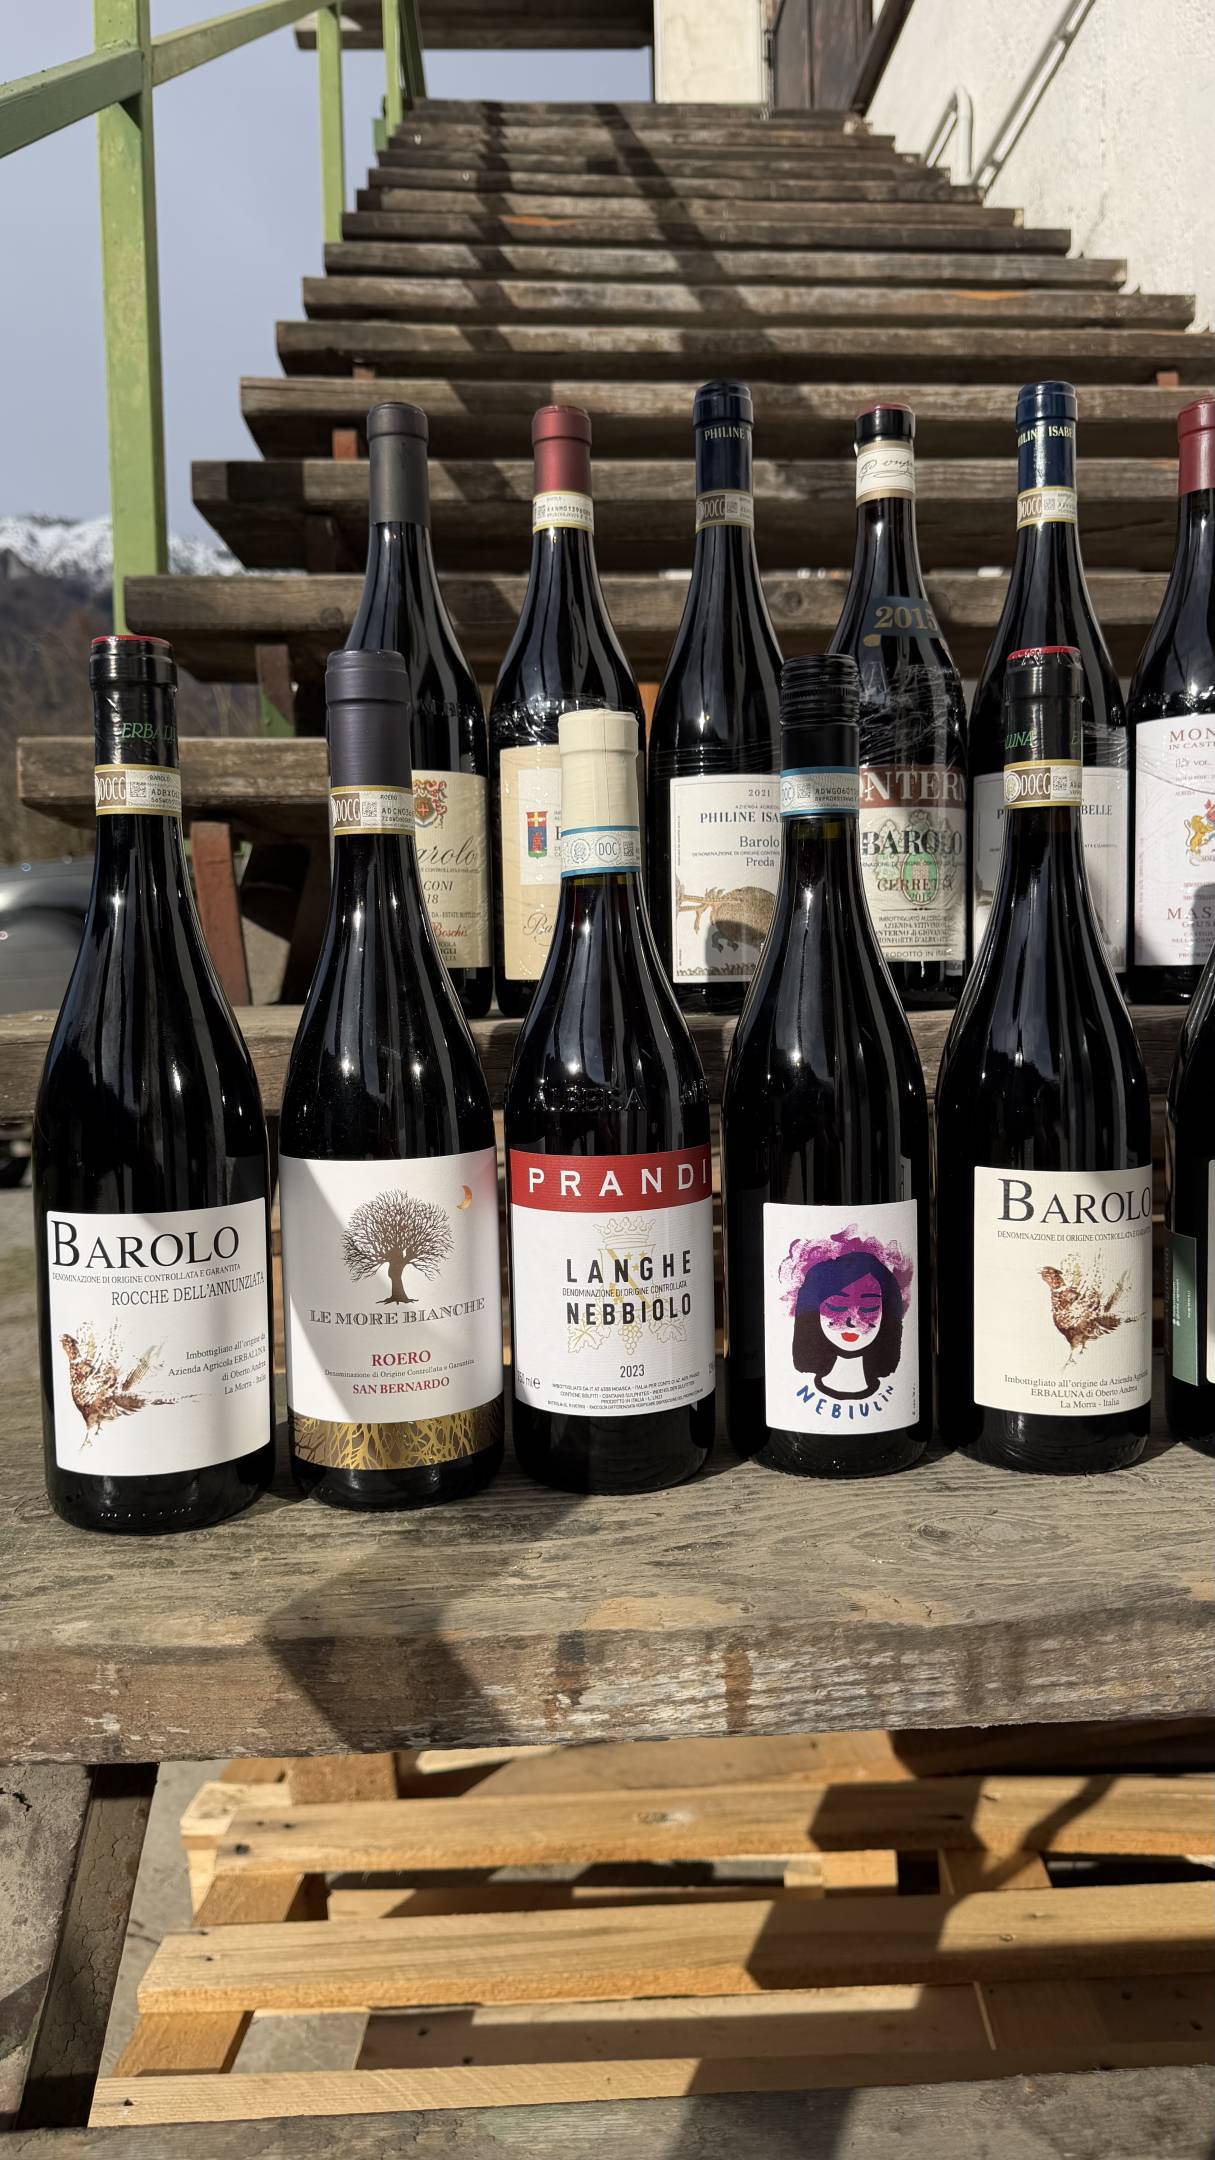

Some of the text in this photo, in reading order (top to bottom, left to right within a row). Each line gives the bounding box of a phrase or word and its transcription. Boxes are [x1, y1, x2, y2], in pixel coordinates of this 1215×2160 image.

[704, 426, 745, 440] PHILINE
[121, 721, 178, 744] ERBALU
[1004, 729, 1035, 750] LUNA
[1169, 727, 1215, 742] MON
[100, 775, 127, 801] DOCG
[748, 788, 771, 797] 2021
[1021, 772, 1051, 797] DOCG
[700, 811, 780, 824] PHILINE ISA
[1081, 804, 1113, 816] BELLE
[416, 834, 478, 866] arolo
[598, 840, 618, 858] DOC
[739, 835, 780, 849] Barolo
[861, 829, 962, 856] BAROLO
[746, 856, 776, 868] Preda
[423, 880, 454, 891] CONI
[427, 894, 439, 905] 18
[1167, 906, 1213, 921] MAS
[528, 1159, 706, 1197] PRANDI
[997, 1178, 1151, 1224] BAROLO
[51, 1220, 239, 1269] BAROLO
[997, 1230, 1056, 1242] DENOMINAZIONE
[1057, 1233, 1064, 1242] DI
[1065, 1233, 1094, 1242] ORIGINE
[111, 1275, 143, 1284] ORIGINE
[144, 1271, 199, 1283] CONTROLLATA
[205, 1263, 241, 1277] GARANTITA
[566, 1249, 691, 1284] LANGHE
[111, 1271, 265, 1306] ROCCHE DELL'ANNUNZIATA
[562, 1280, 688, 1298] DENOMINAZIONE DI ORIGINE CONTROLLATA
[309, 1297, 485, 1326] LE MORE BIANCHE
[566, 1292, 691, 1326] NEBBIOLO
[186, 1342, 233, 1361] Imbottigliato
[371, 1350, 431, 1367] ROERO
[168, 1364, 201, 1377] Azienda
[202, 1357, 233, 1374] Agricola
[324, 1369, 371, 1379] Denominazione
[372, 1369, 379, 1378] di
[380, 1368, 406, 1379] Origine
[406, 1365, 443, 1376] Controllata
[620, 1364, 645, 1378] 2023
[224, 1385, 234, 1395] La
[352, 1377, 450, 1395] SAN BERNARDO
[1004, 1374, 1056, 1389] Imbottigliato
[1058, 1378, 1098, 1390] all'origine
[1099, 1378, 1108, 1387] da
[1031, 1388, 1084, 1399] ERBALUNA
[1086, 1389, 1093, 1398] di
[1095, 1387, 1119, 1398] Oberto
[1060, 1400, 1070, 1409] La
[1073, 1399, 1097, 1409] Morra
[1103, 1398, 1120, 1408] Italia
